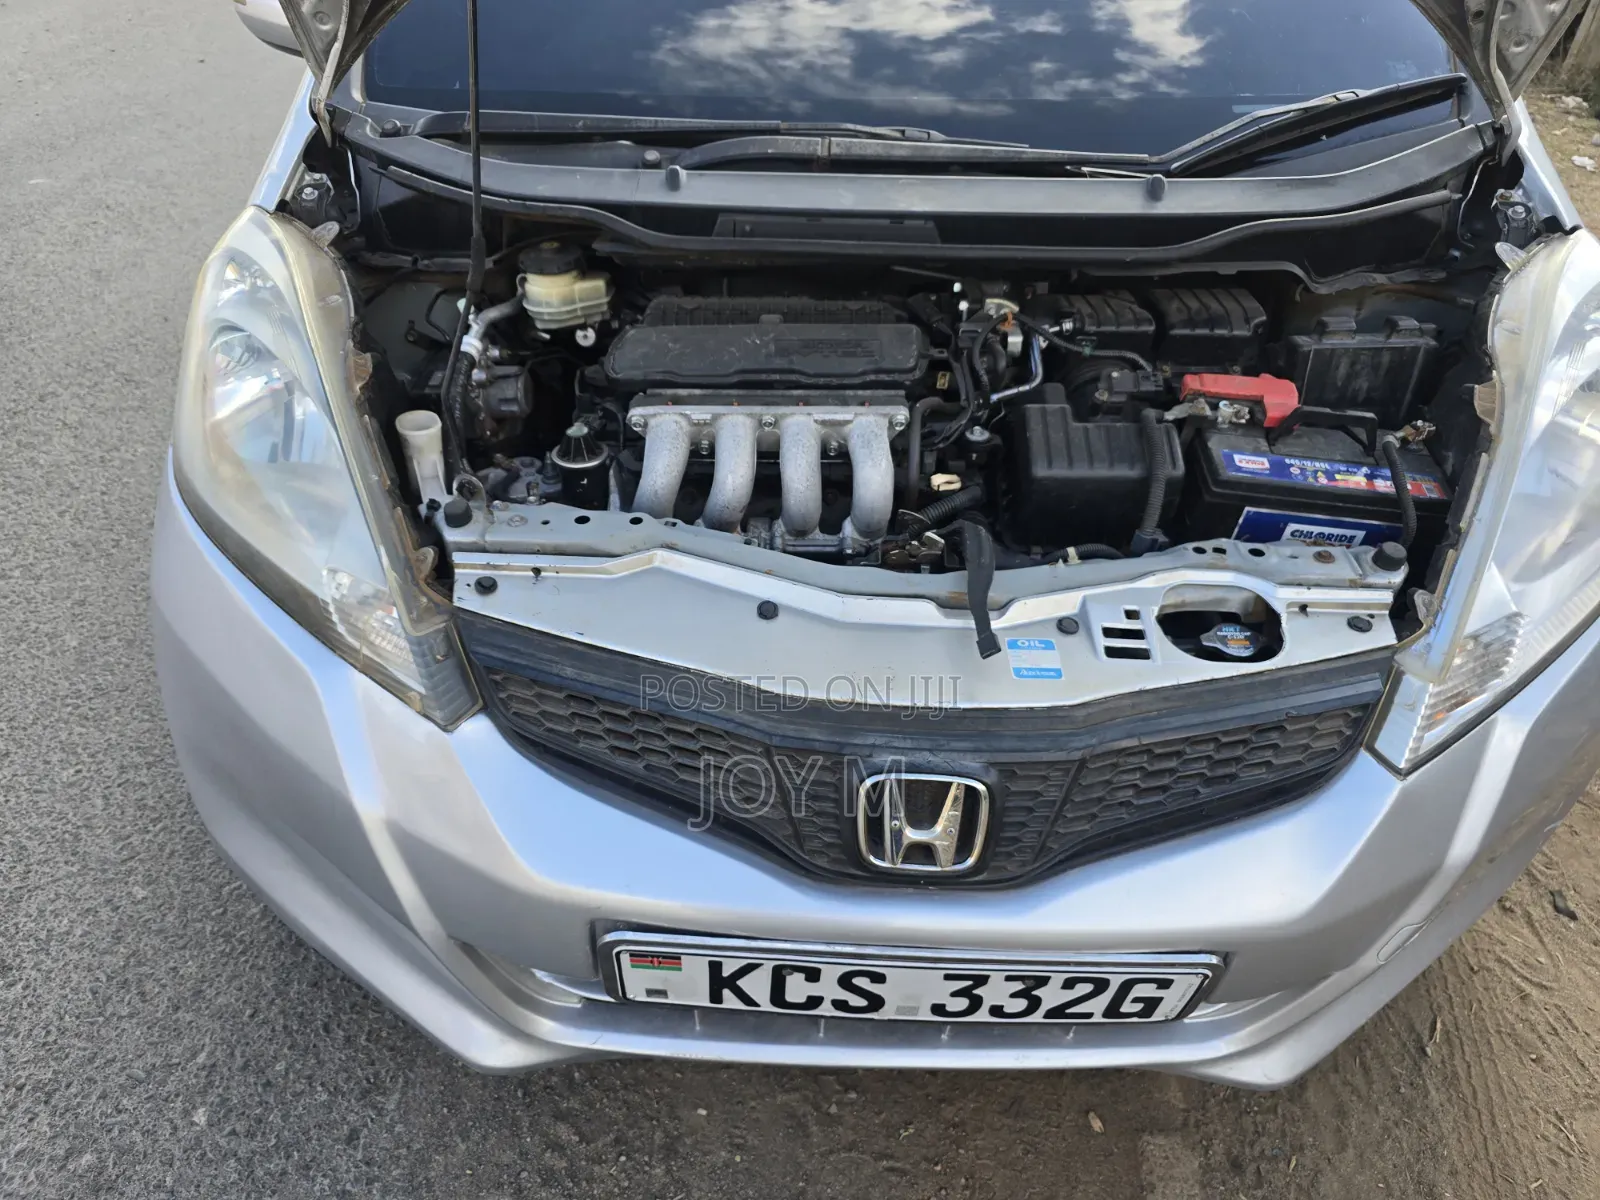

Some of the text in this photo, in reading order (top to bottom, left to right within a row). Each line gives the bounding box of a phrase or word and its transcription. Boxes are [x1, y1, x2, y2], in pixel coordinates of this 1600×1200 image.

[1290, 529, 1357, 544] CHLORIDE
[1016, 640, 1046, 648] OIL
[708, 960, 886, 1014] KCS
[930, 973, 1175, 1019] 332G
